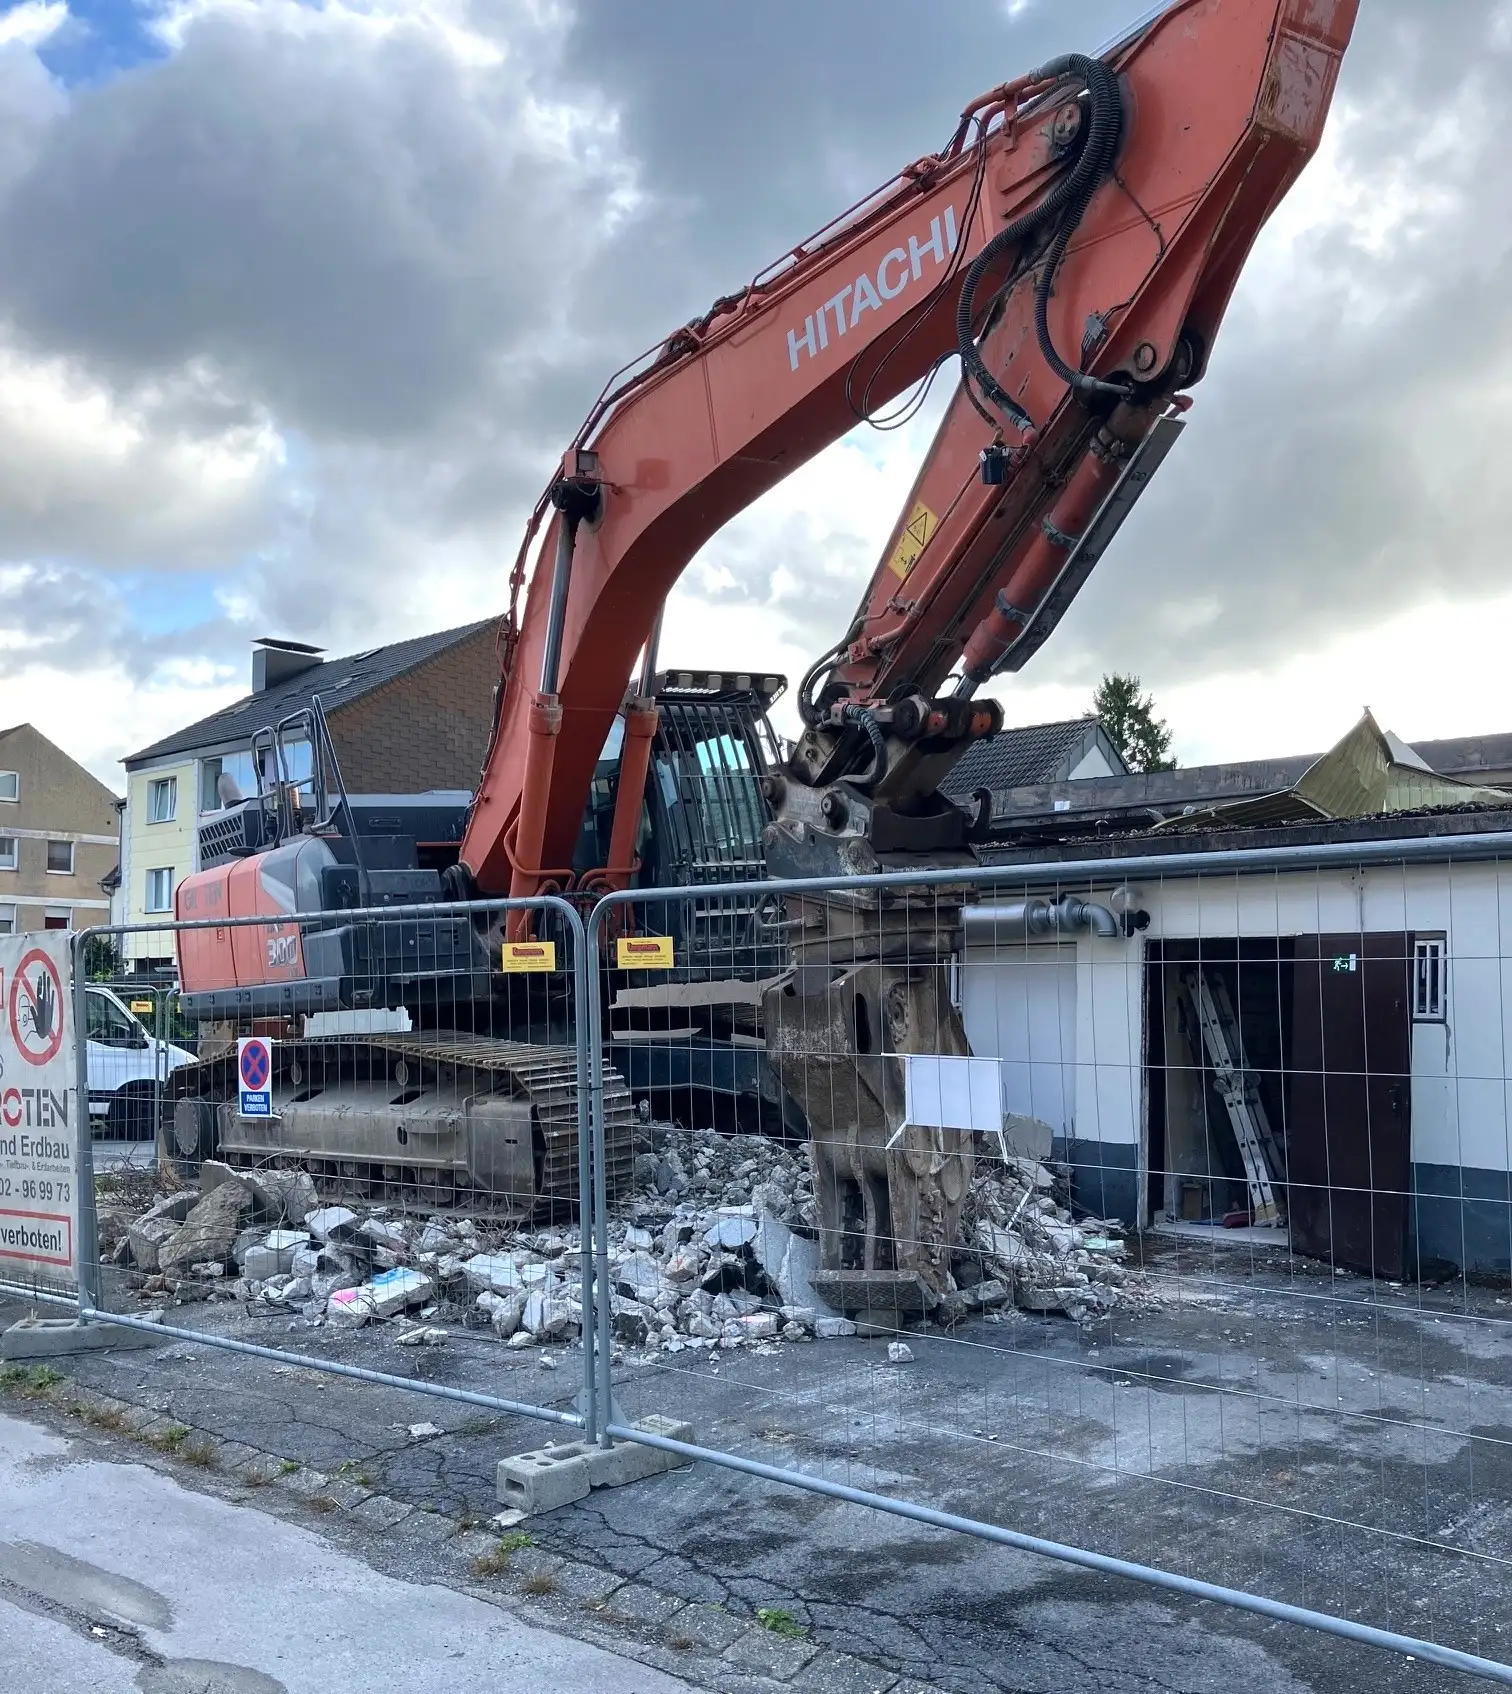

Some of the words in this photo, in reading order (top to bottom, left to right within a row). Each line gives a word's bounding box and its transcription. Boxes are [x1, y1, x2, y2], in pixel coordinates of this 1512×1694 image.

[787, 205, 958, 371] HITACHI
[0, 1087, 68, 1127] OTEN
[244, 1103, 268, 1112] VERBOTEN
[246, 1094, 265, 1103] PARKEN
[21, 1135, 70, 1160] Erdbau
[22, 1180, 36, 1199] 96
[39, 1181, 53, 1201] 99
[57, 1183, 71, 1203] 73
[0, 1225, 62, 1252] verboten!
